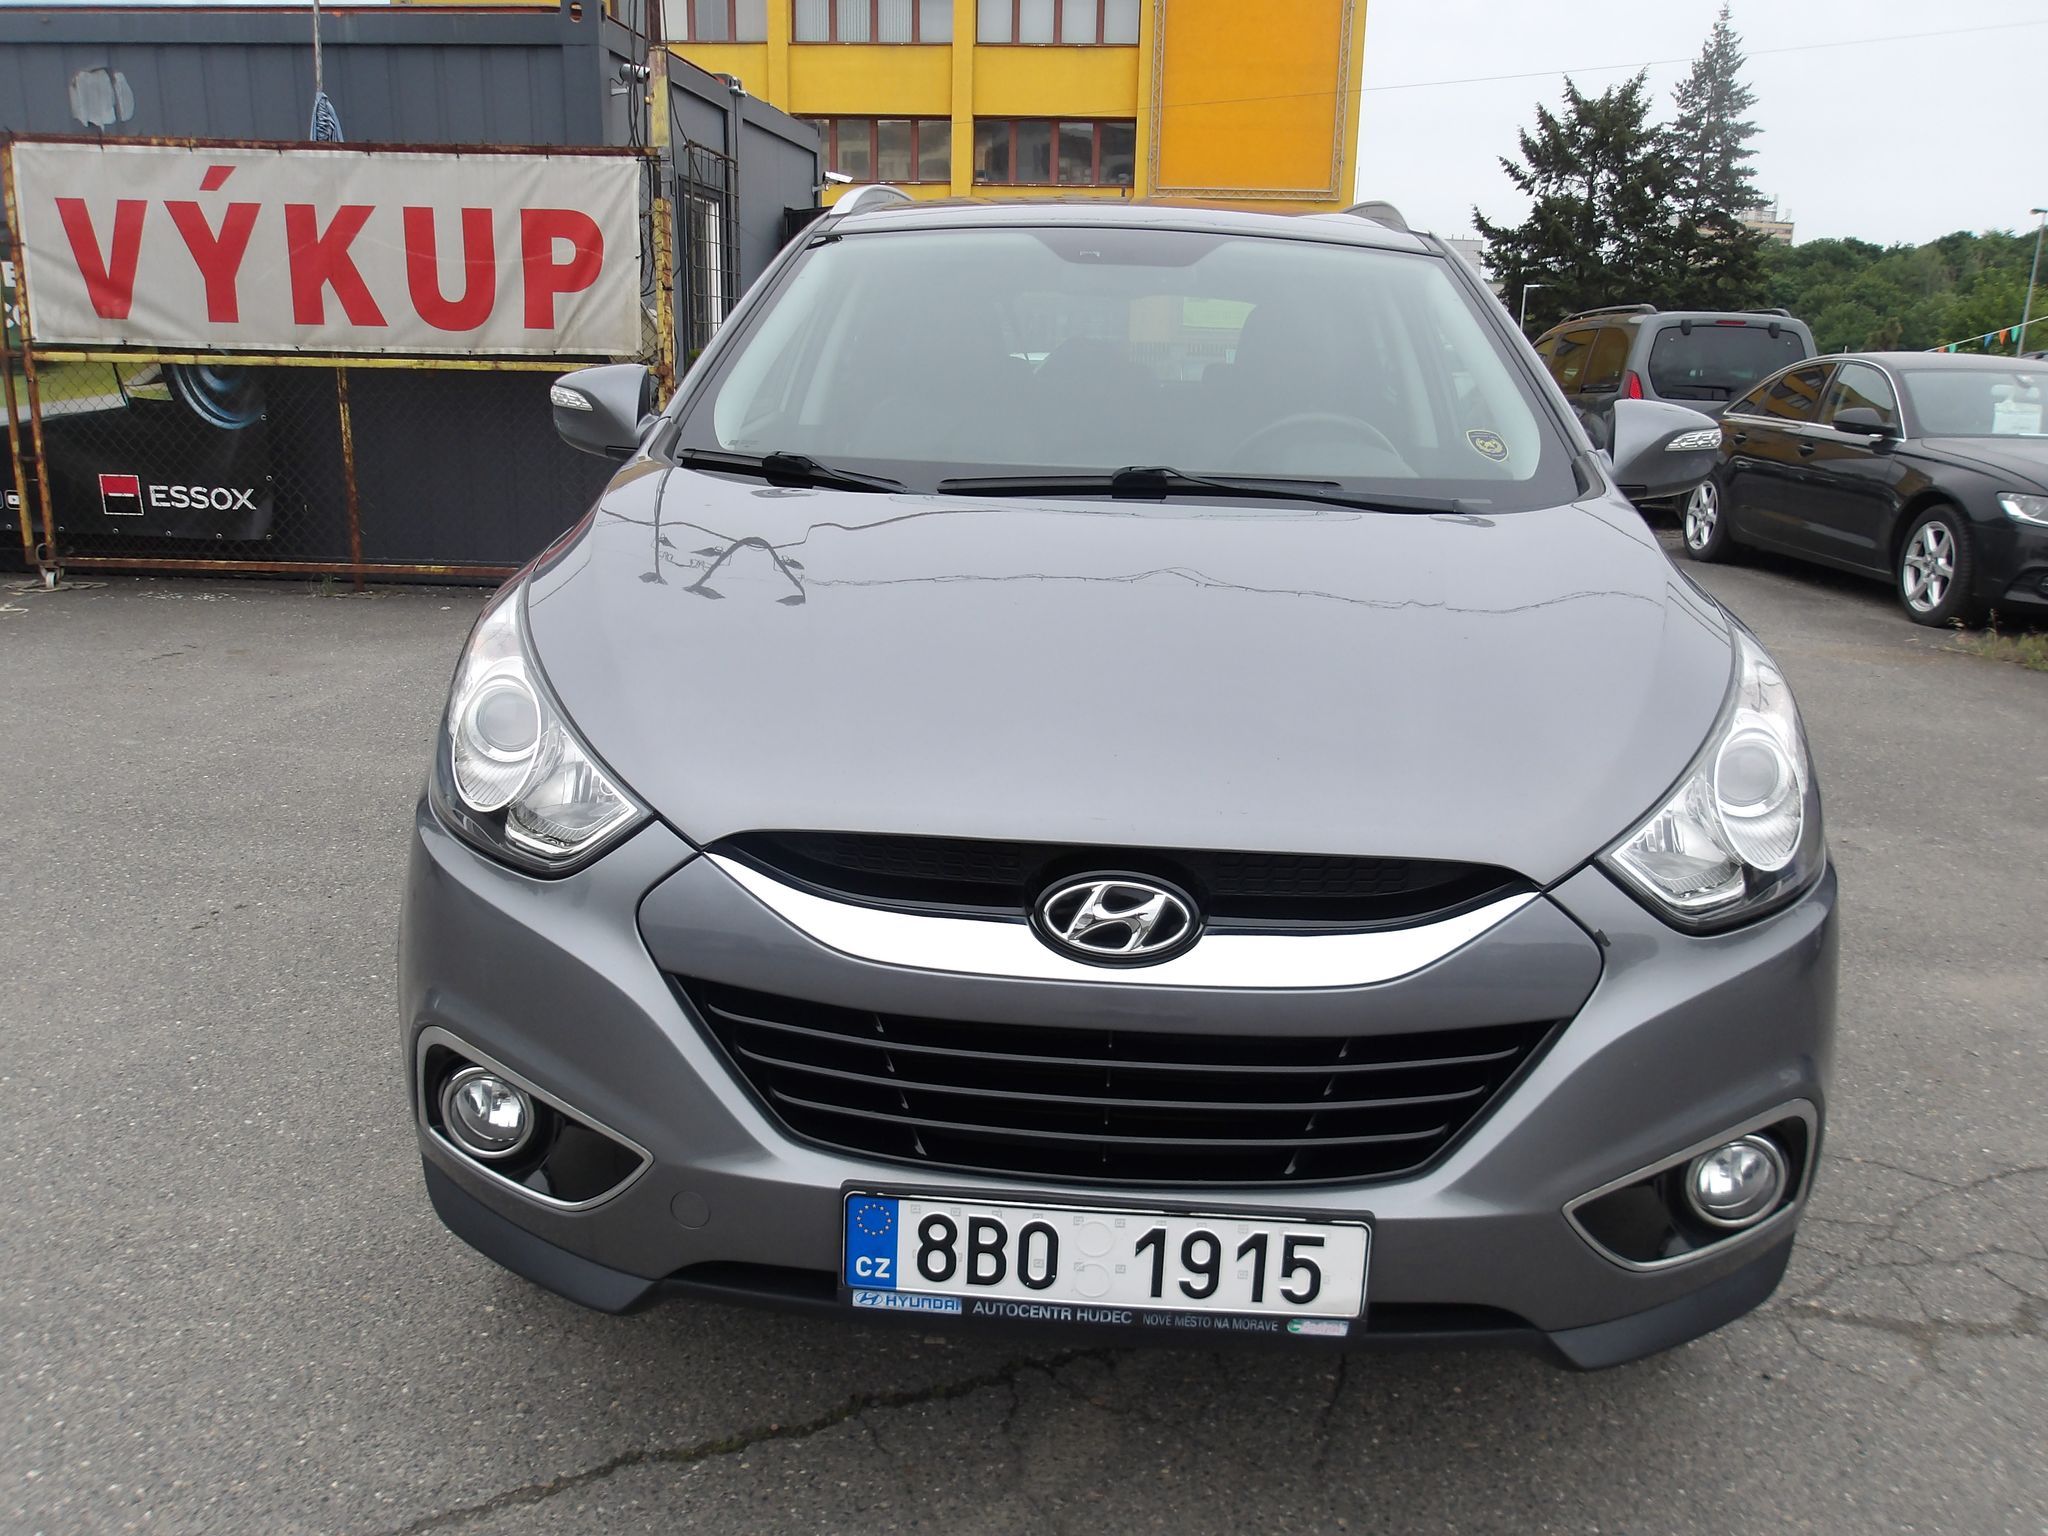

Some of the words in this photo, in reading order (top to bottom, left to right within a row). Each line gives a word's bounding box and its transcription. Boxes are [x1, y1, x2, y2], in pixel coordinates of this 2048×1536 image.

[55, 165, 604, 332] VÝKUP
[148, 484, 257, 511] ESSOX
[855, 1256, 891, 1278] CZ
[916, 1213, 1059, 1291] 8B0
[1134, 1228, 1326, 1305] 1915
[885, 1294, 960, 1312] HYUNDAI
[972, 1300, 1072, 1321] AUTOCENTR
[1076, 1307, 1133, 1324] HUDEC
[1213, 1317, 1230, 1329] NA
